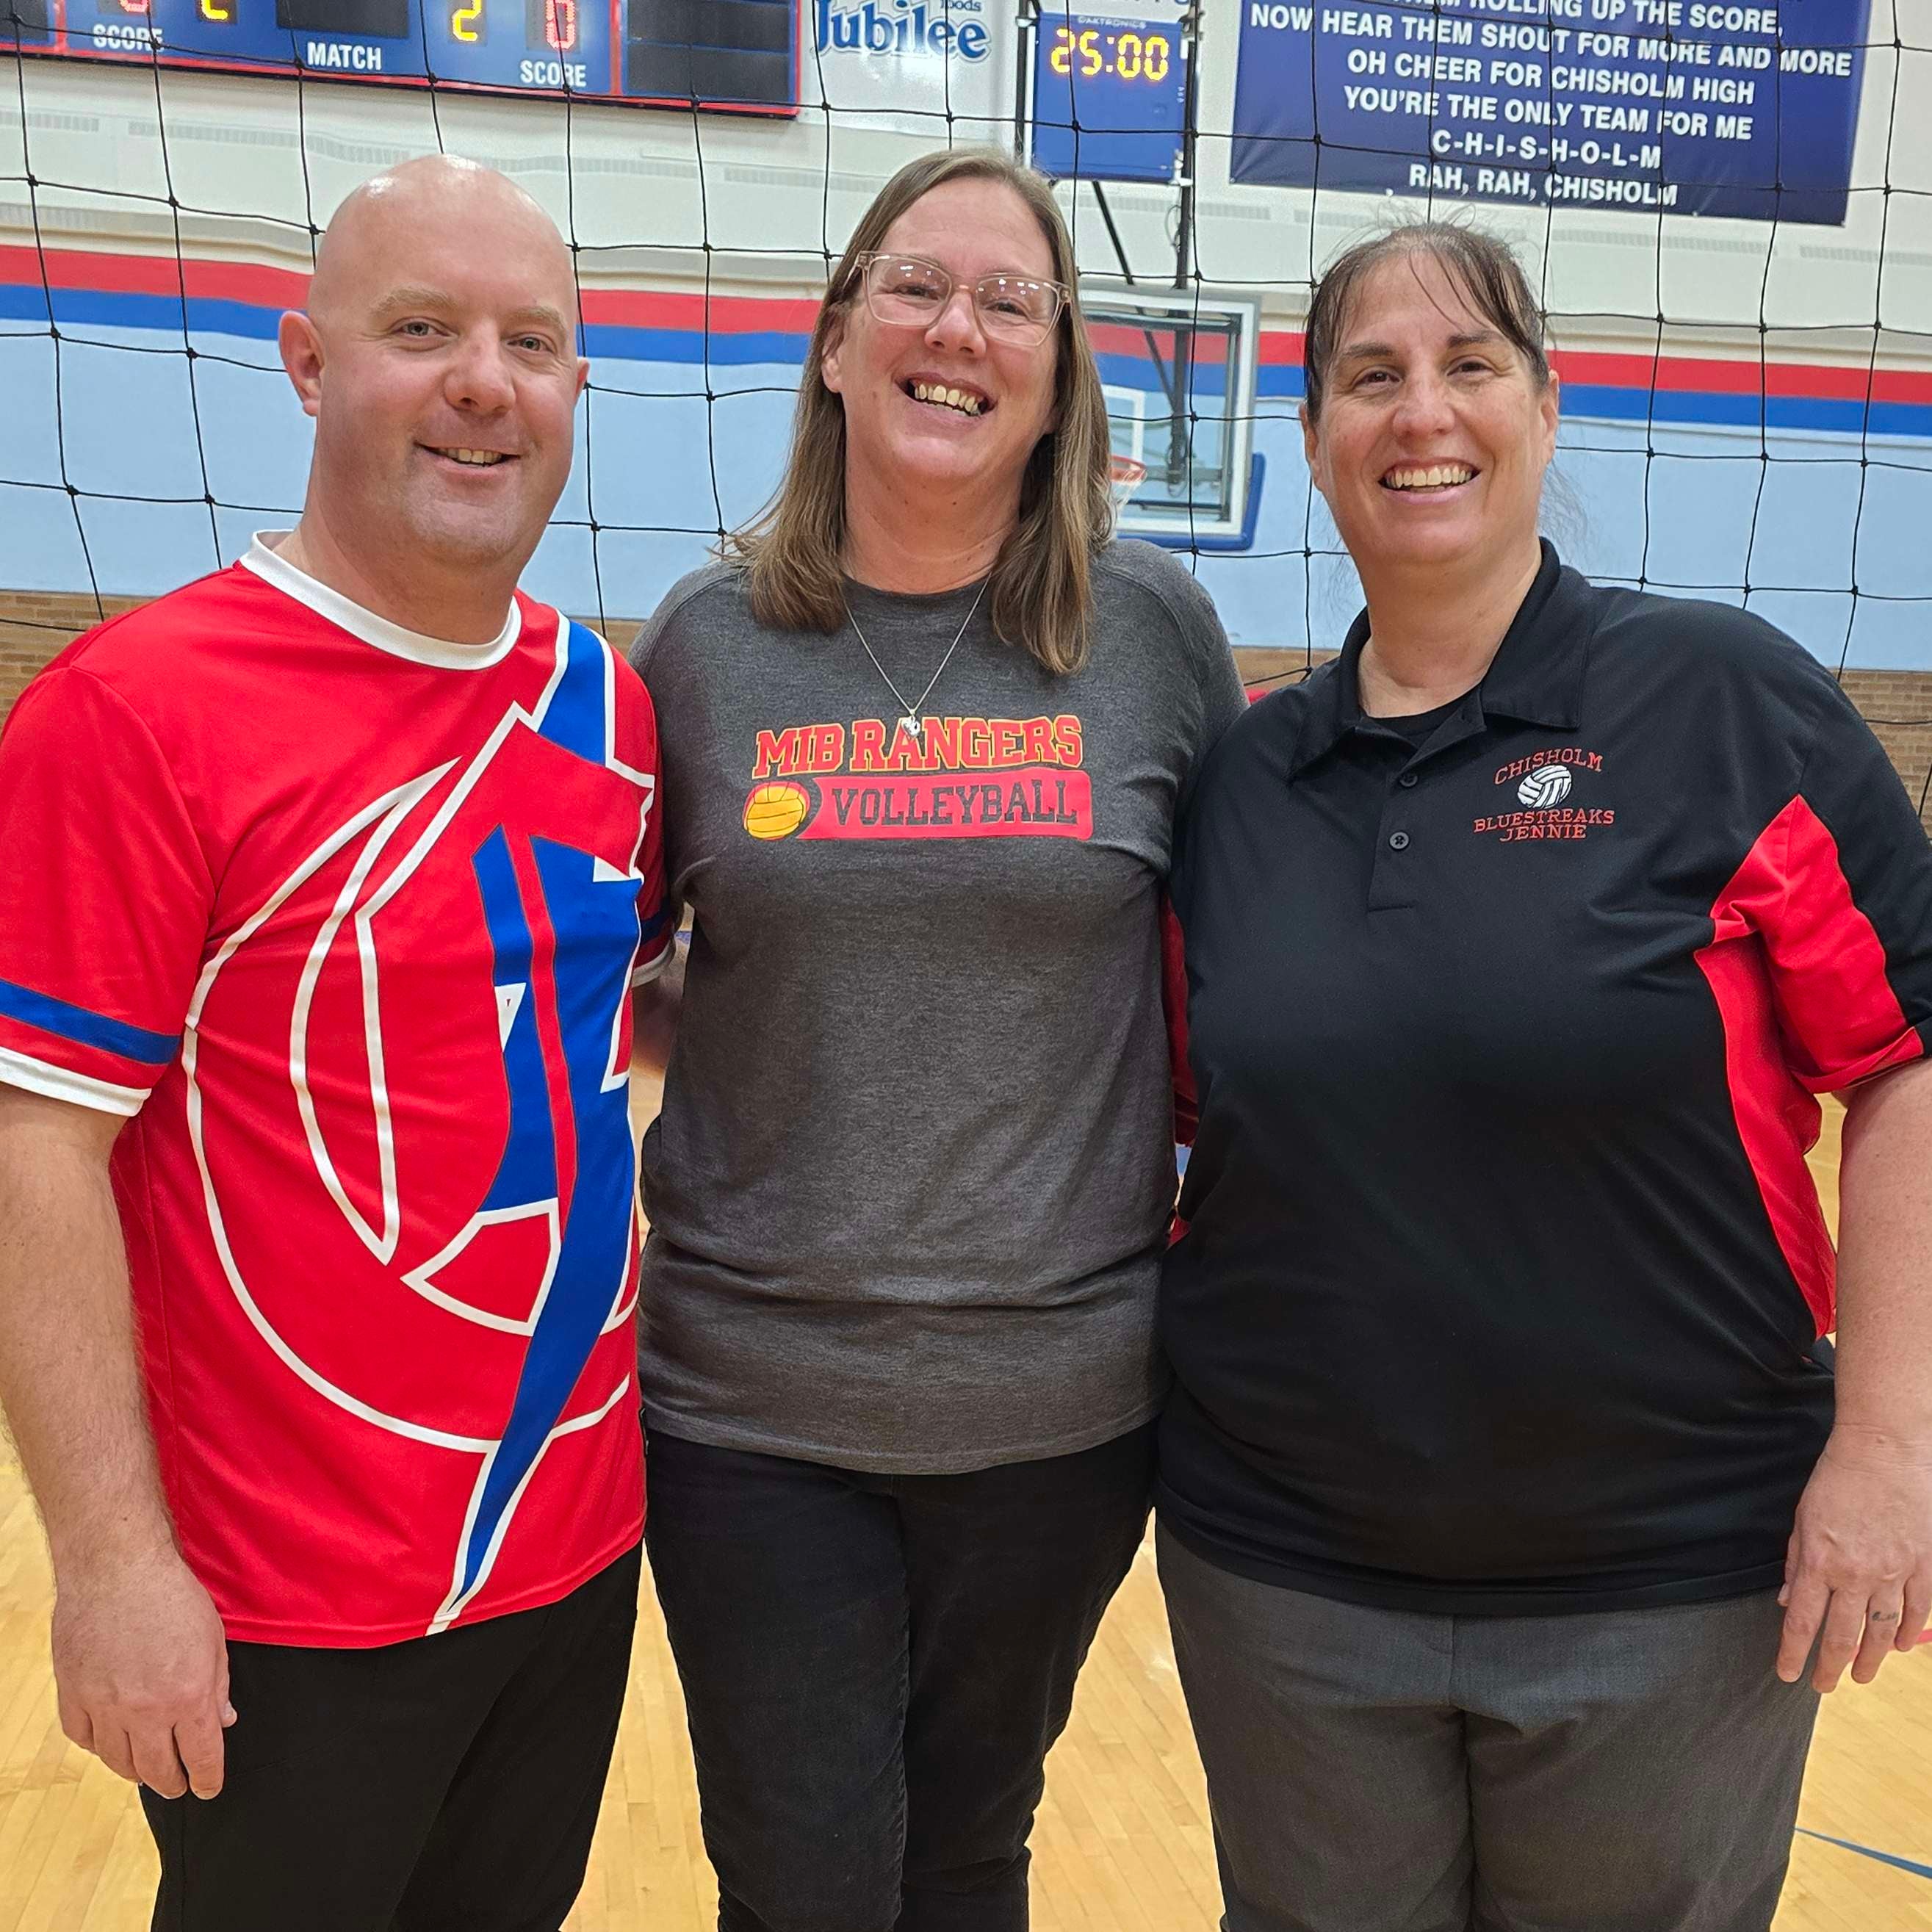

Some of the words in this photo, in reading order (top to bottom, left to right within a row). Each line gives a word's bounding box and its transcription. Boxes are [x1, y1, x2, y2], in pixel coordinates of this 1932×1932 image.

[93, 24, 164, 51] SCORE
[546, 0, 575, 49] 0
[815, 0, 987, 59] Jubilee
[1591, 0, 1626, 21] UP
[1633, 0, 1681, 26] THE
[1690, 7, 1783, 37] SCORE,
[307, 41, 382, 71] MATCH
[1051, 28, 1169, 81] 25:00
[1250, 4, 1312, 31] NOW
[1323, 10, 1392, 38] HEAR
[1402, 16, 1471, 45] THEM
[1481, 24, 1571, 54] SHOUT
[1578, 32, 1629, 58] FOR
[1637, 39, 1711, 65] MORE
[1718, 46, 1771, 70] AND
[1781, 49, 1852, 76] MORE
[520, 60, 587, 87] SCORE
[1347, 49, 1386, 74] OH
[1395, 54, 1481, 82] CHEER
[1491, 61, 1541, 87] FOR
[1551, 66, 1684, 98] CHISHOLM
[1693, 77, 1755, 104] HIGH
[1344, 85, 1439, 115] YOU'RE
[1447, 95, 1497, 120] THE
[1504, 100, 1573, 126] ONLY
[1580, 104, 1648, 134] TEAM
[1657, 110, 1707, 137] FOR
[1715, 115, 1753, 140] ME
[1432, 129, 1662, 169] C-H-I-S-H-O-L-M
[1409, 164, 1468, 195] RAH,
[1477, 170, 1537, 201] RAH,
[1544, 173, 1678, 206] CHISHOLM
[752, 723, 846, 779] MIB
[849, 715, 1083, 771] RANGERS
[1493, 748, 1604, 785] CHISHOLM
[832, 779, 1078, 826] VOLLEYBALL
[1474, 808, 1615, 833] BLUESTREAKS
[1499, 824, 1587, 843] JENNIE
